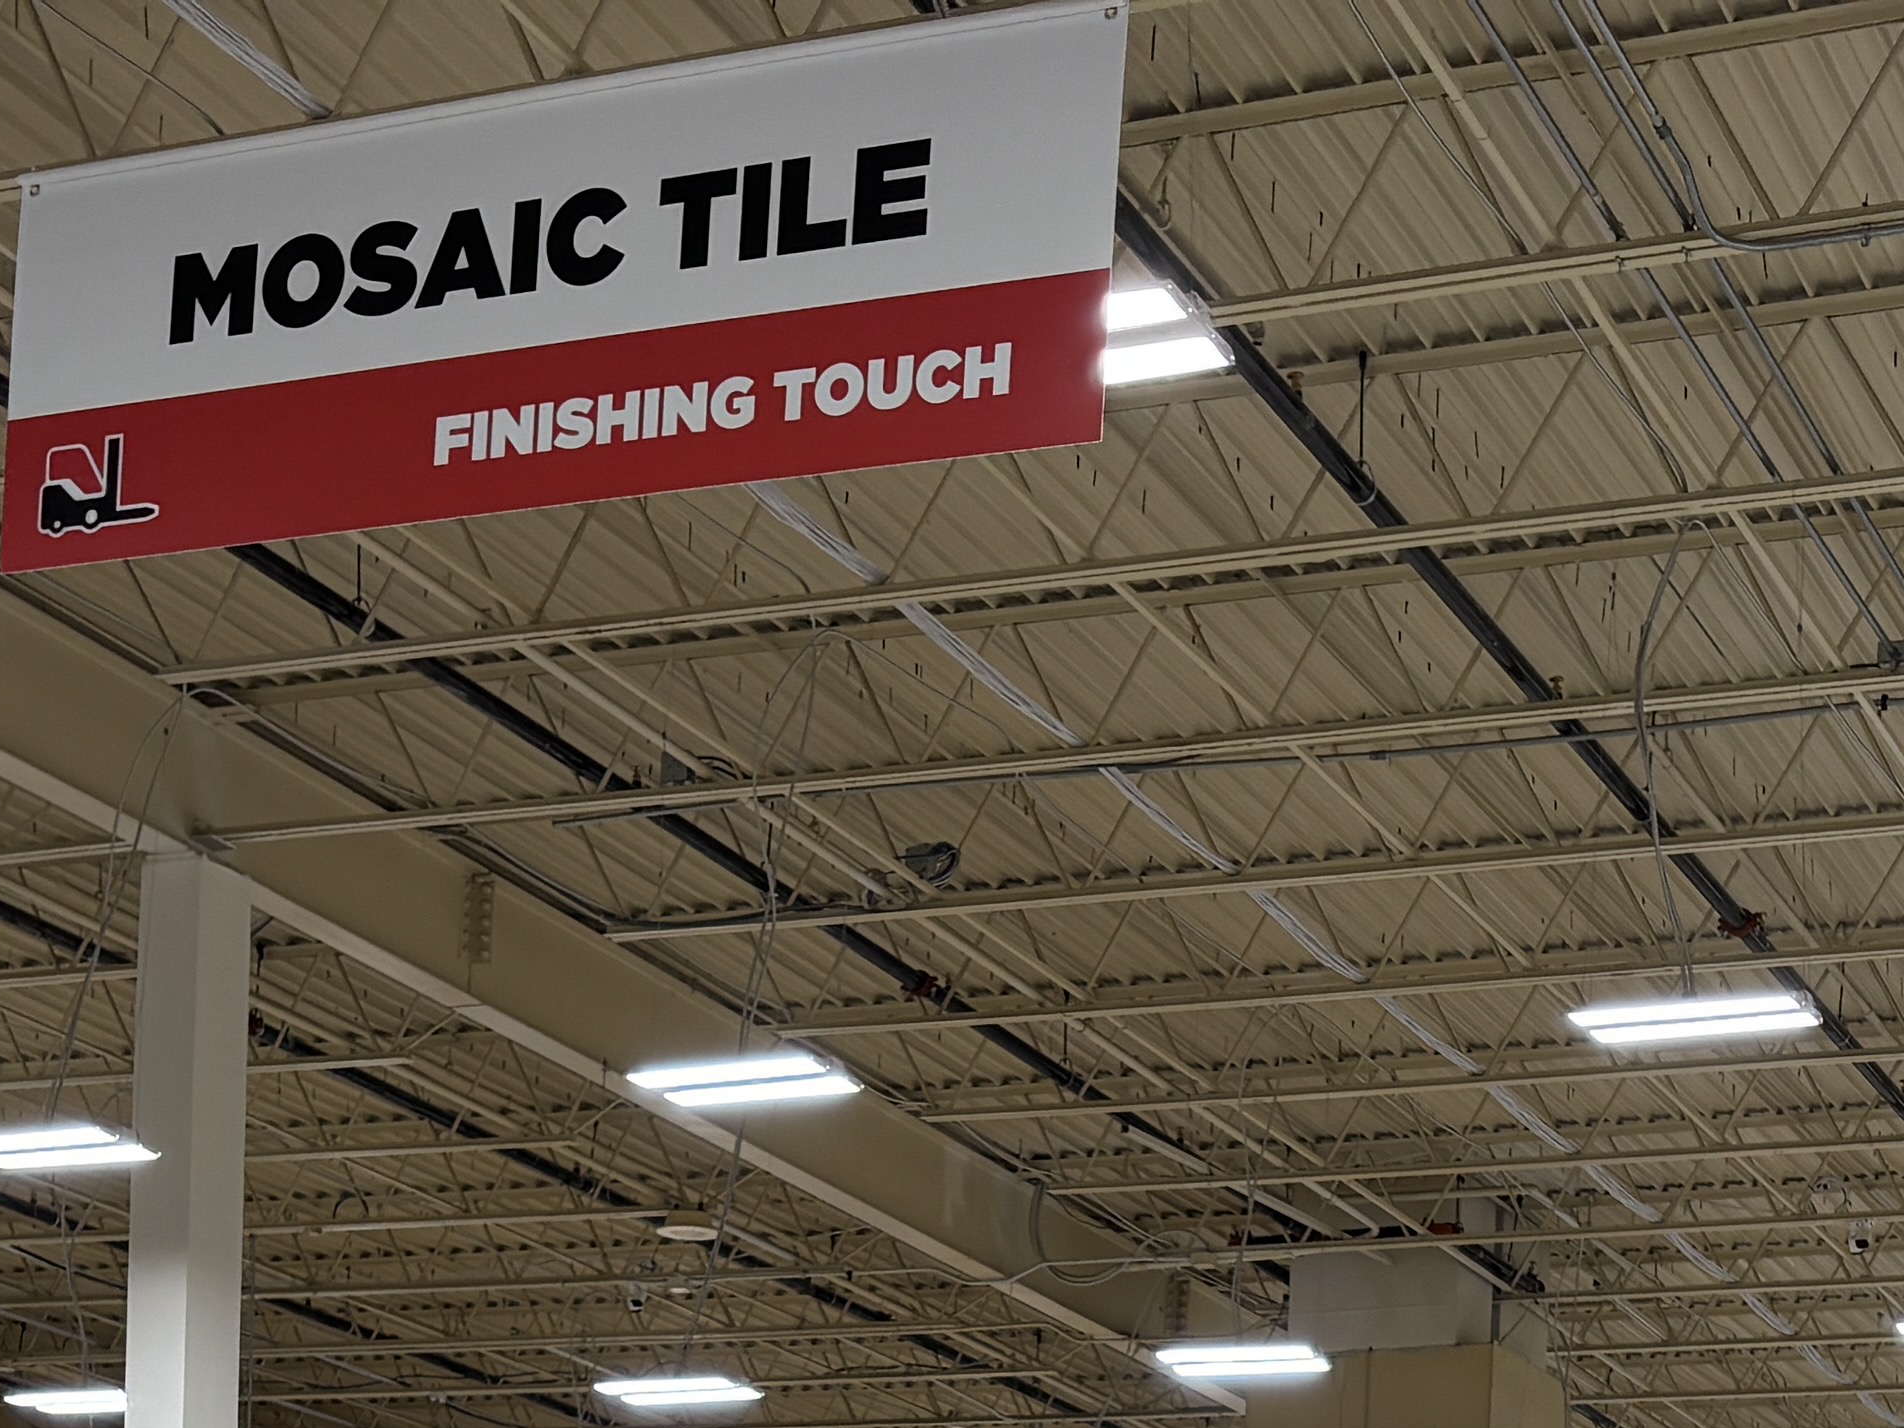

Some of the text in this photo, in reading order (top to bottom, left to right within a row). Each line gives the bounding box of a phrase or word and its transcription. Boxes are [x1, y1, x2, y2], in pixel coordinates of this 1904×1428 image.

[168, 137, 932, 346] MOSAIC TILE
[432, 341, 1012, 466] FINISHING TOUCH
